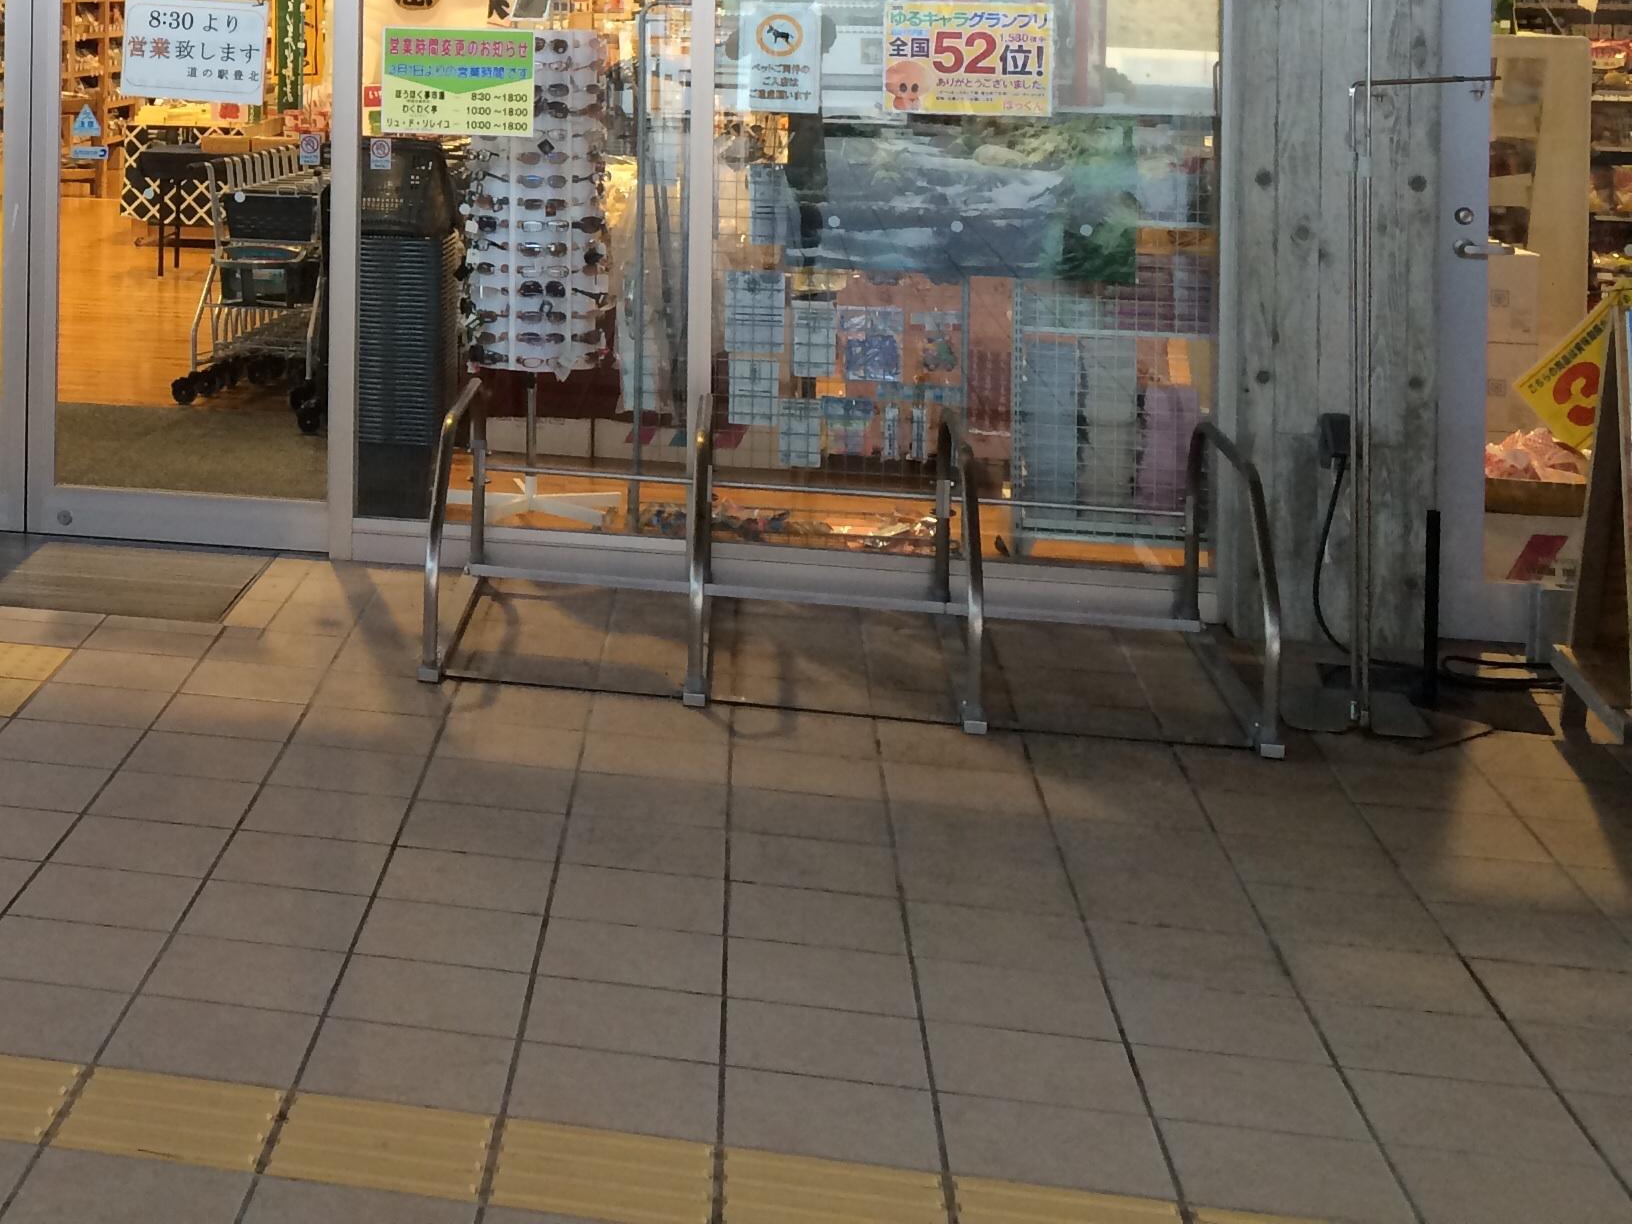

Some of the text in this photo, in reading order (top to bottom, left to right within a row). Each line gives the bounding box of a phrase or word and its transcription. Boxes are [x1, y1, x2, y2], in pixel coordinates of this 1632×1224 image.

[148, 10, 238, 34] 8:30 より
[889, 11, 1048, 29] ゆるキャラグランプリ
[127, 35, 261, 64] 営業致します
[389, 37, 529, 58] 営業時間変更のお知らせ
[888, 36, 930, 59] 全国
[932, 31, 997, 75] 52
[186, 66, 260, 82] 道の駅豊北
